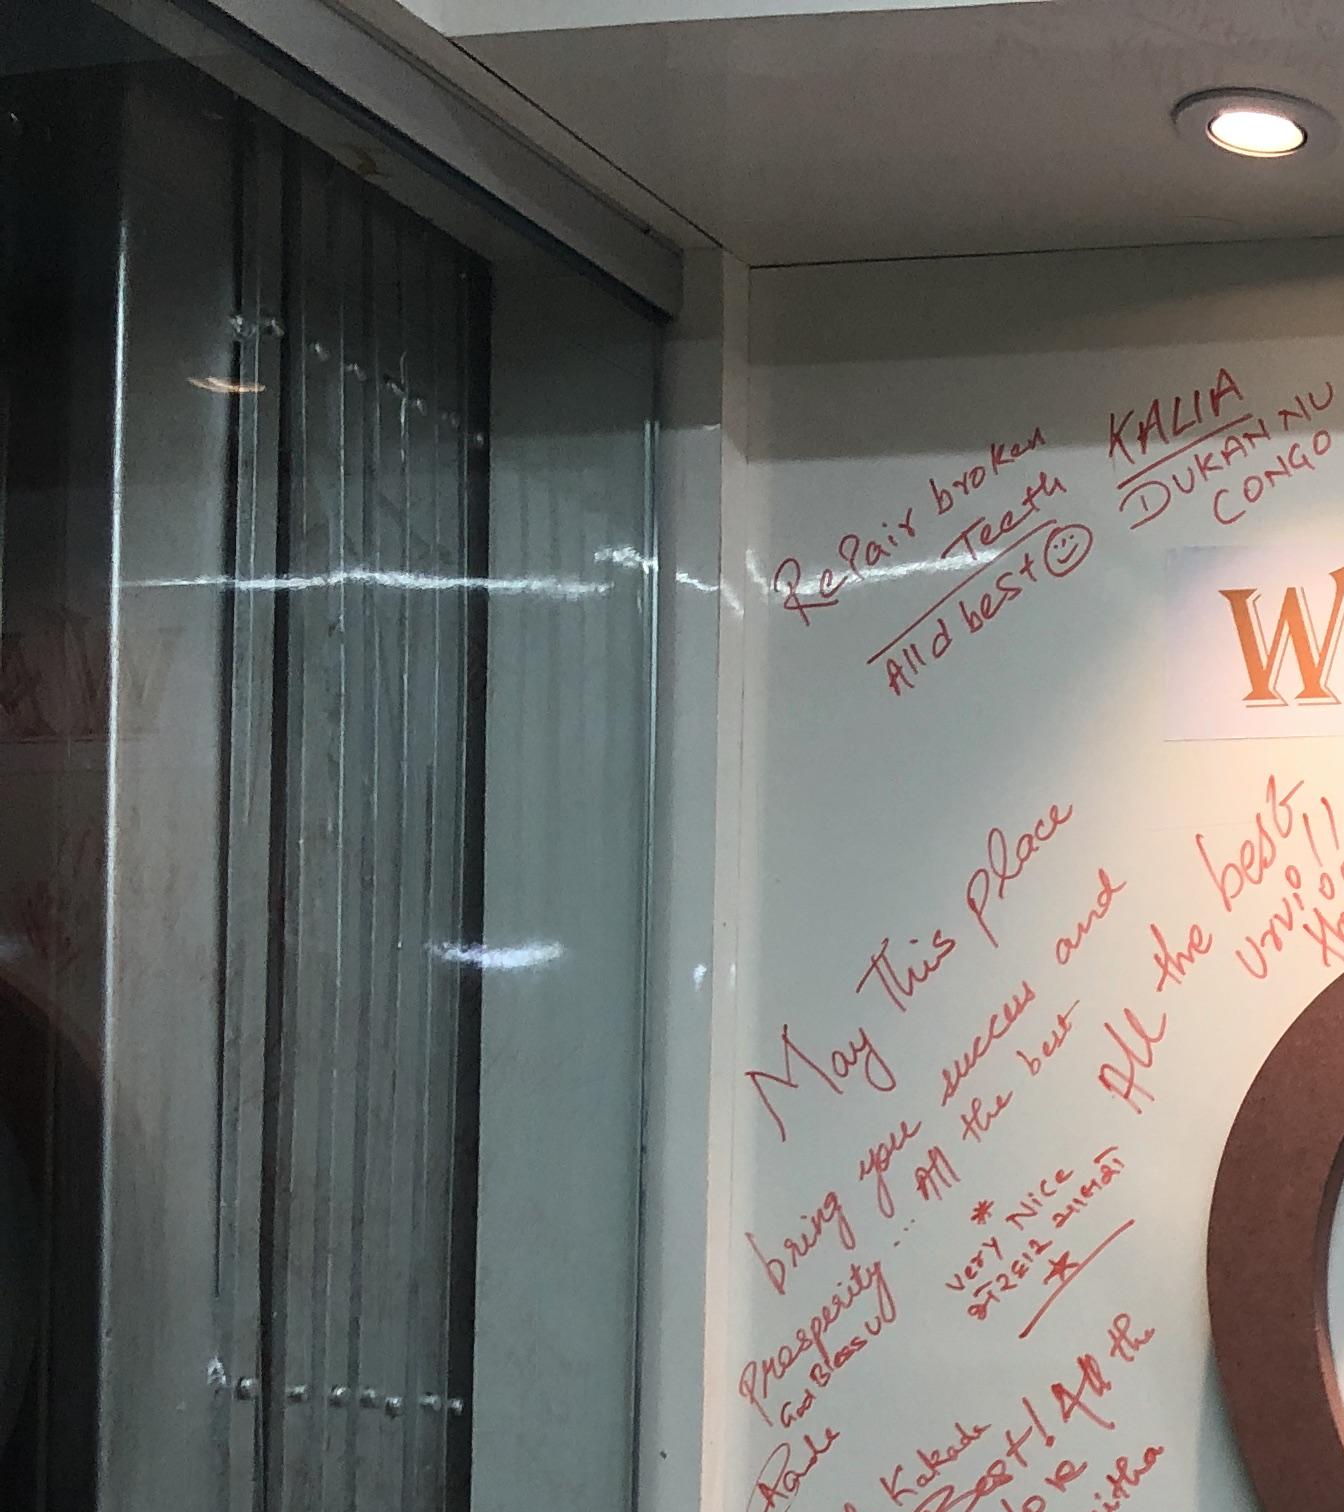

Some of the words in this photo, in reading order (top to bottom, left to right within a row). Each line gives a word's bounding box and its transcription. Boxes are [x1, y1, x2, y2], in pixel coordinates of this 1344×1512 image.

[1107, 368, 1244, 463] KALIA
[1118, 418, 1271, 531] DUKAN
[1282, 381, 1336, 435] NU
[930, 427, 1046, 513] broken
[1212, 430, 1332, 526] CONGO
[966, 556, 1038, 635] best
[1150, 924, 1213, 992] the
[745, 1024, 897, 1142] May
[746, 1191, 856, 1294] bring
[859, 1121, 922, 1218] you
[941, 982, 1036, 1105] success
[1055, 868, 1127, 965] and
[961, 1092, 1013, 1142] the
[1018, 1001, 1080, 1077] best
[1108, 1313, 1156, 1362] the
